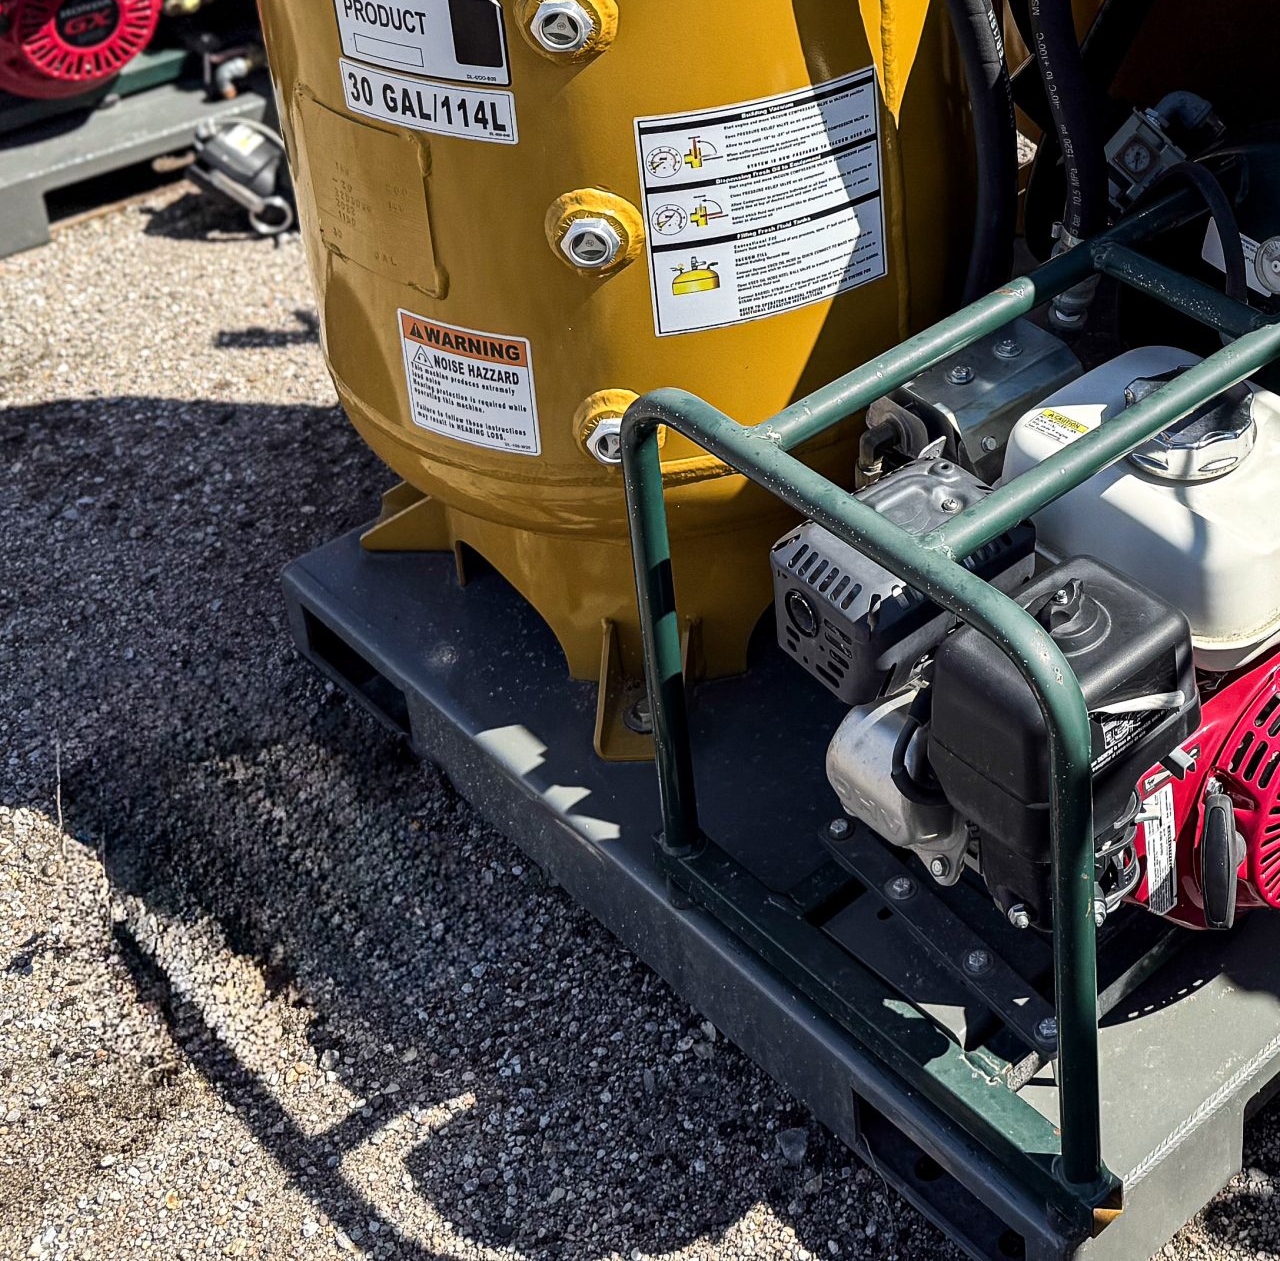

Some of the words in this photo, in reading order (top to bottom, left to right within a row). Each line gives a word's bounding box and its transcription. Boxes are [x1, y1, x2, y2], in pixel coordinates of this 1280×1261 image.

[348, 72, 373, 107] 30
[382, 84, 507, 132] GAL/114L
[741, 106, 768, 120] Building
[768, 102, 795, 115] Vacuum
[715, 171, 752, 185] Dispensing
[751, 166, 771, 178] Fresh
[772, 163, 782, 174] Oil
[736, 228, 757, 240] Filling
[757, 224, 776, 236] Fresh
[776, 220, 793, 231] Fluid
[793, 216, 812, 228] Tanks
[424, 325, 520, 361] WARNING
[411, 362, 422, 373] This
[424, 369, 449, 381] machine
[450, 375, 480, 389] produces
[481, 384, 515, 396] extremely
[433, 355, 465, 375] NOISE
[467, 364, 519, 385] HAZZARD
[436, 386, 468, 402] protection
[478, 398, 506, 410] required
[508, 402, 527, 413] while
[416, 401, 437, 414] Failure
[445, 412, 464, 424] follow
[485, 422, 527, 437] instructions
[456, 423, 485, 437] HEARING
